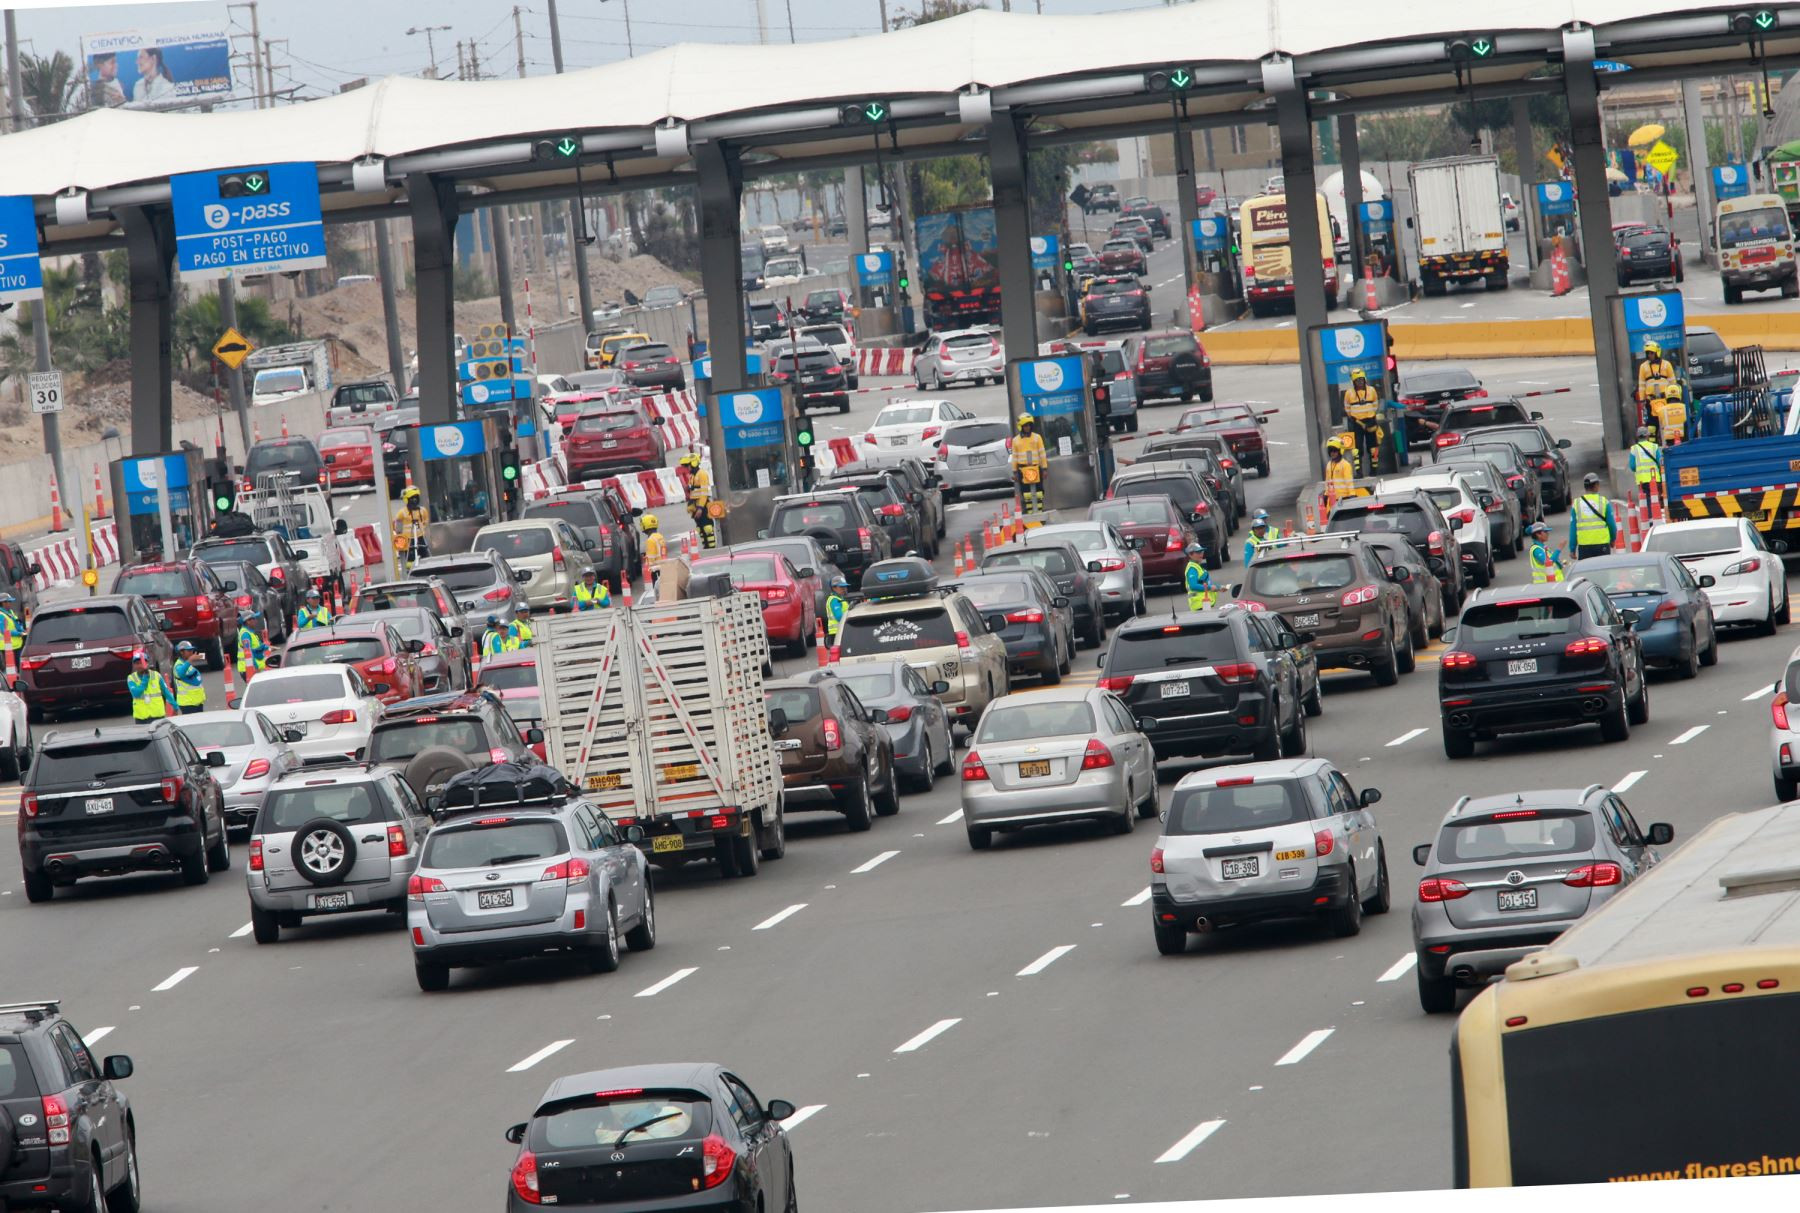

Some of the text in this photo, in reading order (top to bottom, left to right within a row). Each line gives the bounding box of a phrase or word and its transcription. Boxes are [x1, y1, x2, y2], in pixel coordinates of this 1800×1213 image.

[209, 202, 291, 225] e-pass
[213, 231, 288, 249] POST-PAGO
[194, 243, 309, 266] PAGO EN EFECTIVO
[37, 389, 58, 404] 30
[1494, 642, 1546, 651] PORSCHE
[1509, 662, 1537, 673] AVK-050
[1224, 862, 1258, 876] C1B-398
